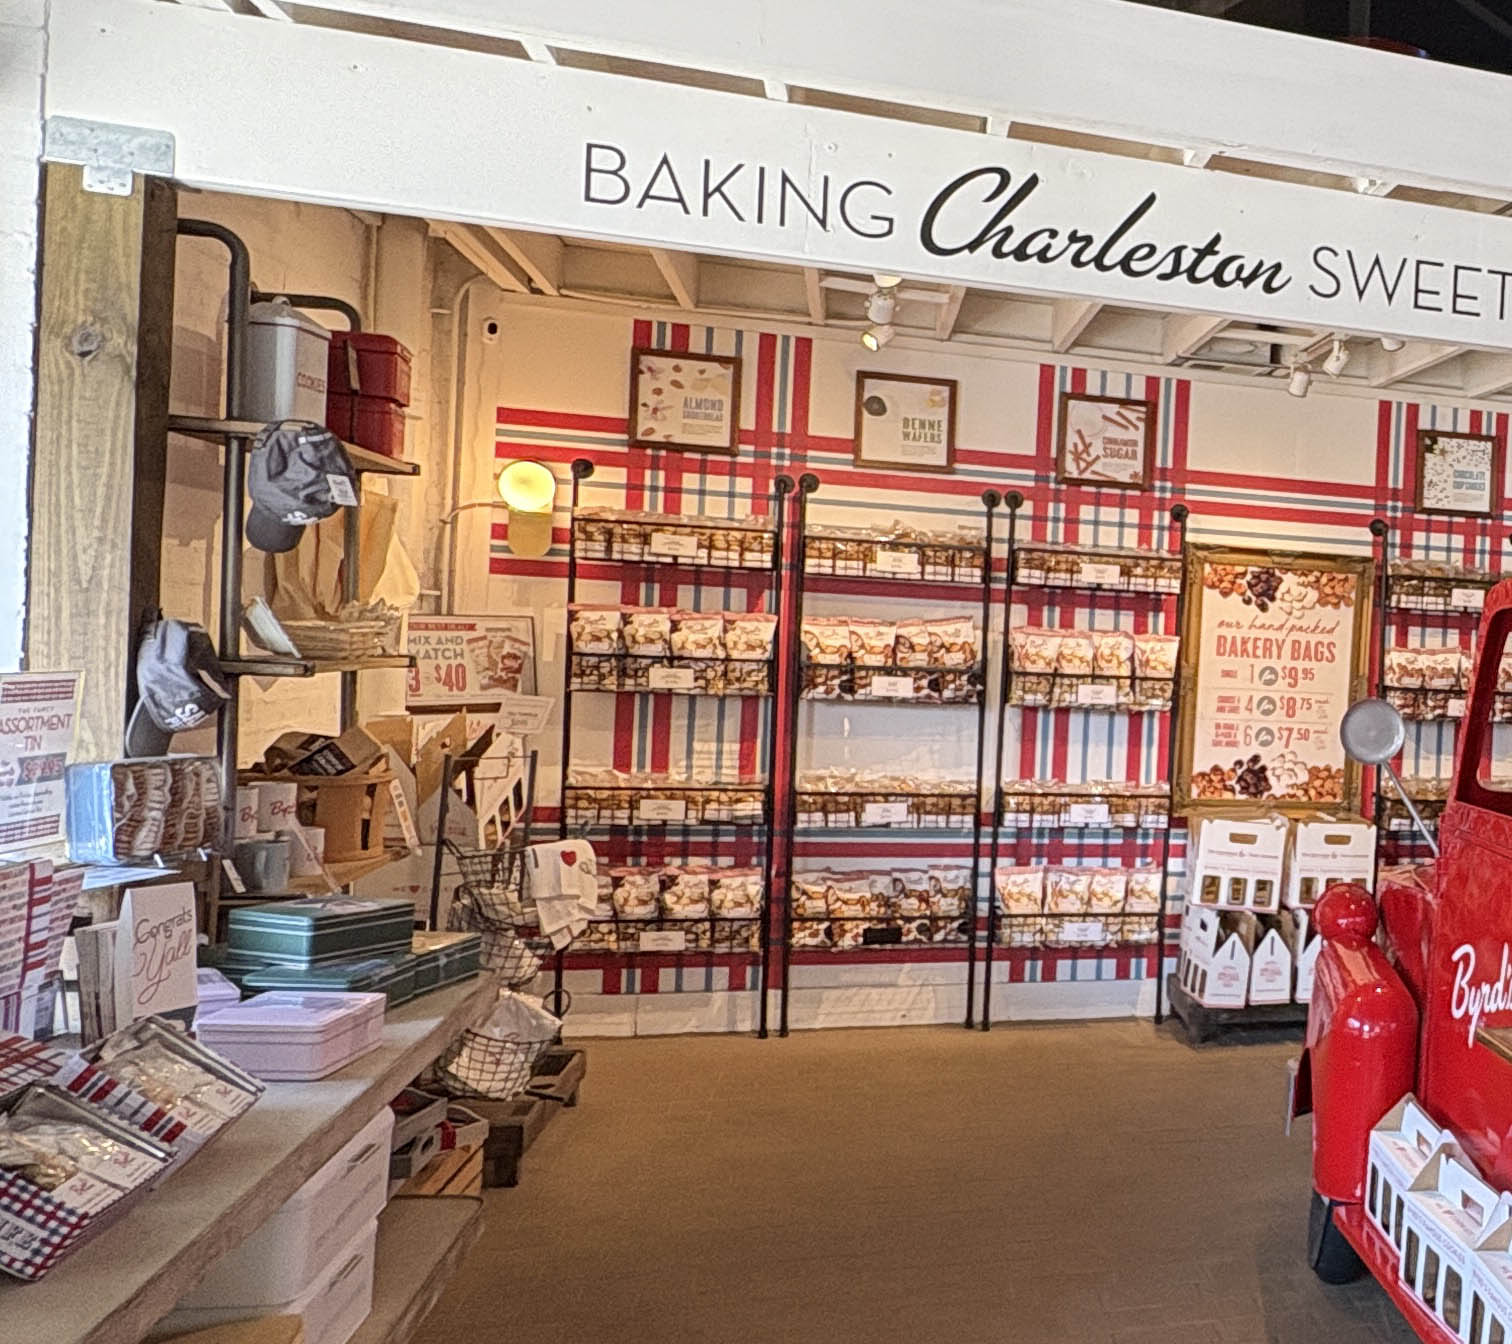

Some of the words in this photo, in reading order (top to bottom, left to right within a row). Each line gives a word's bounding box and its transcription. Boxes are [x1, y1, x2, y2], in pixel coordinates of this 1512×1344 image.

[583, 142, 895, 239] BAKING
[918, 166, 1292, 296] Charleston
[436, 636, 464, 646] AND
[1215, 634, 1287, 660] BAKERY
[1290, 639, 1337, 664] BAGS
[434, 663, 467, 693] $40
[24, 735, 42, 753] TIN
